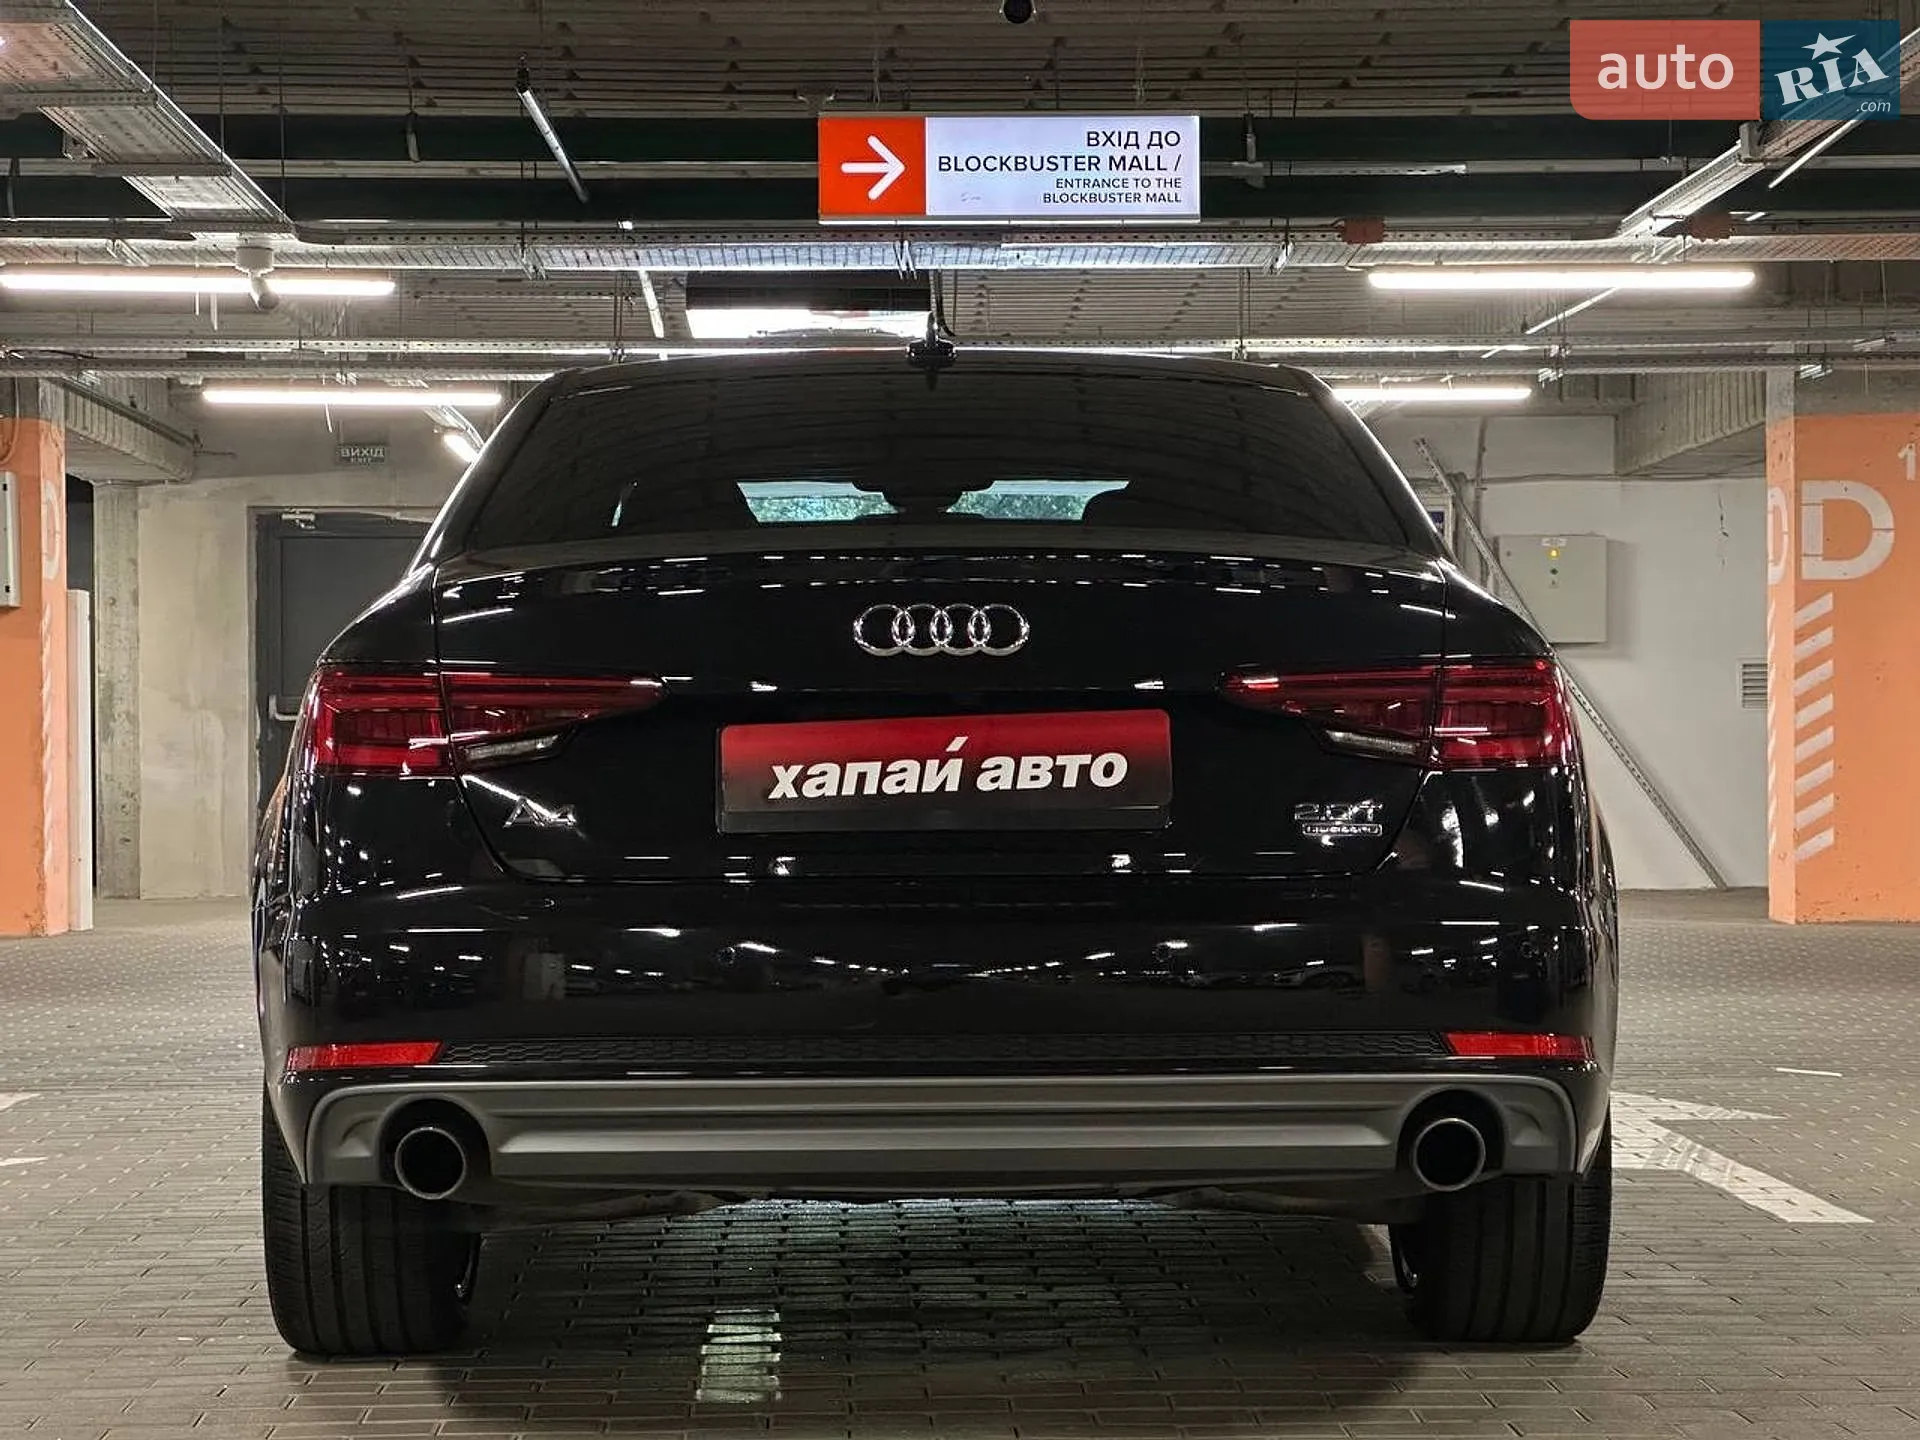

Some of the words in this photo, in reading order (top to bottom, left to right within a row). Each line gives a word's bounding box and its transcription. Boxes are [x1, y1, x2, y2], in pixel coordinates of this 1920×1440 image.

[1087, 130, 1139, 149] ВХІД
[1147, 131, 1181, 149] ДО
[938, 155, 1101, 172] BLOCKBUSTER
[1108, 155, 1167, 171] MALL
[1173, 155, 1181, 173] /
[1055, 178, 1129, 189] ENTRANCE
[1133, 178, 1151, 189] TO
[1156, 177, 1182, 189] THE
[1042, 192, 1142, 204] BLOCKBUSTER
[1146, 192, 1182, 204] MALL
[1800, 480, 1895, 580] D
[976, 752, 1128, 792] авто
